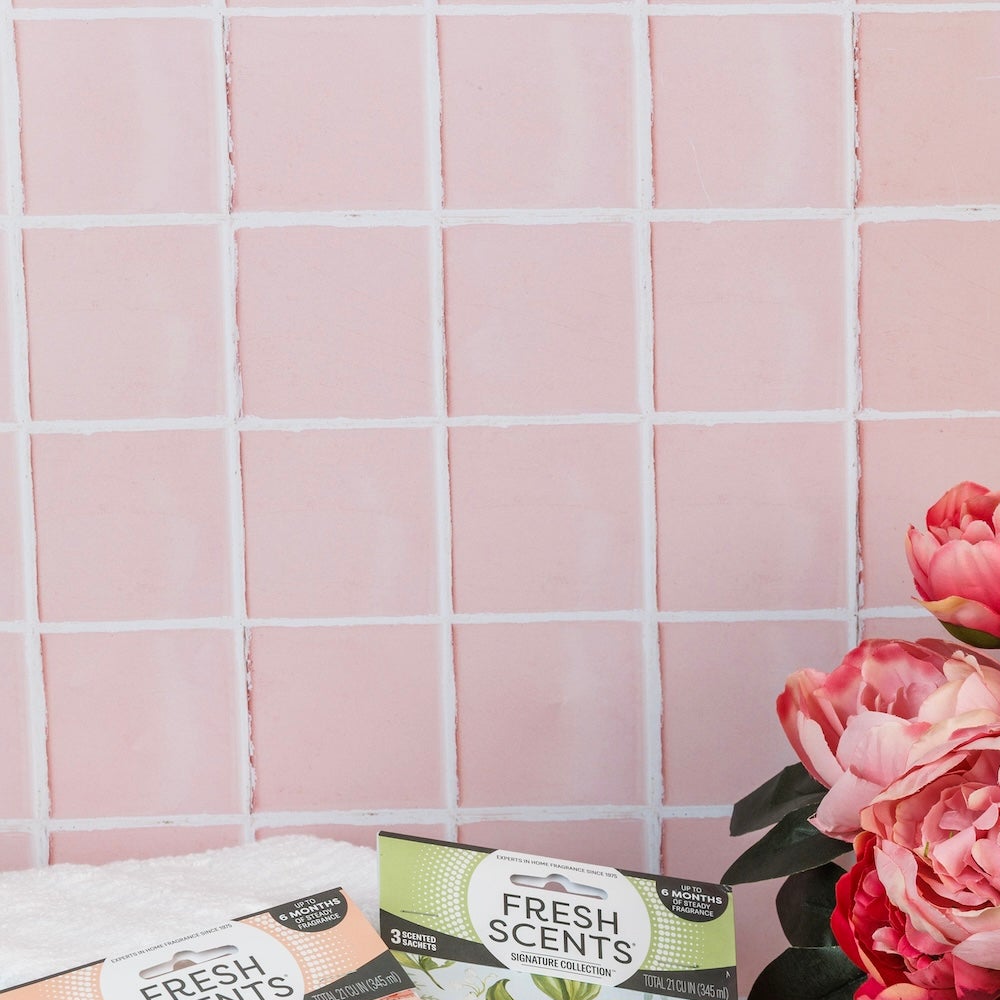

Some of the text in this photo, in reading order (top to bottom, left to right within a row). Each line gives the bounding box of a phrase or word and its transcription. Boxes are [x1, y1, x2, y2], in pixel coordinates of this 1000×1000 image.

[660, 888, 723, 905] 6 MONTHS
[278, 898, 341, 922] 6 MONTHS
[671, 905, 715, 918] FRAGRANCE
[672, 899, 711, 911] OF STEADY
[502, 893, 619, 935] FRESH
[390, 928, 402, 944] 3
[401, 931, 437, 944] SCENTED
[402, 938, 437, 952] SACHETS
[510, 952, 558, 969] SIGNATURE
